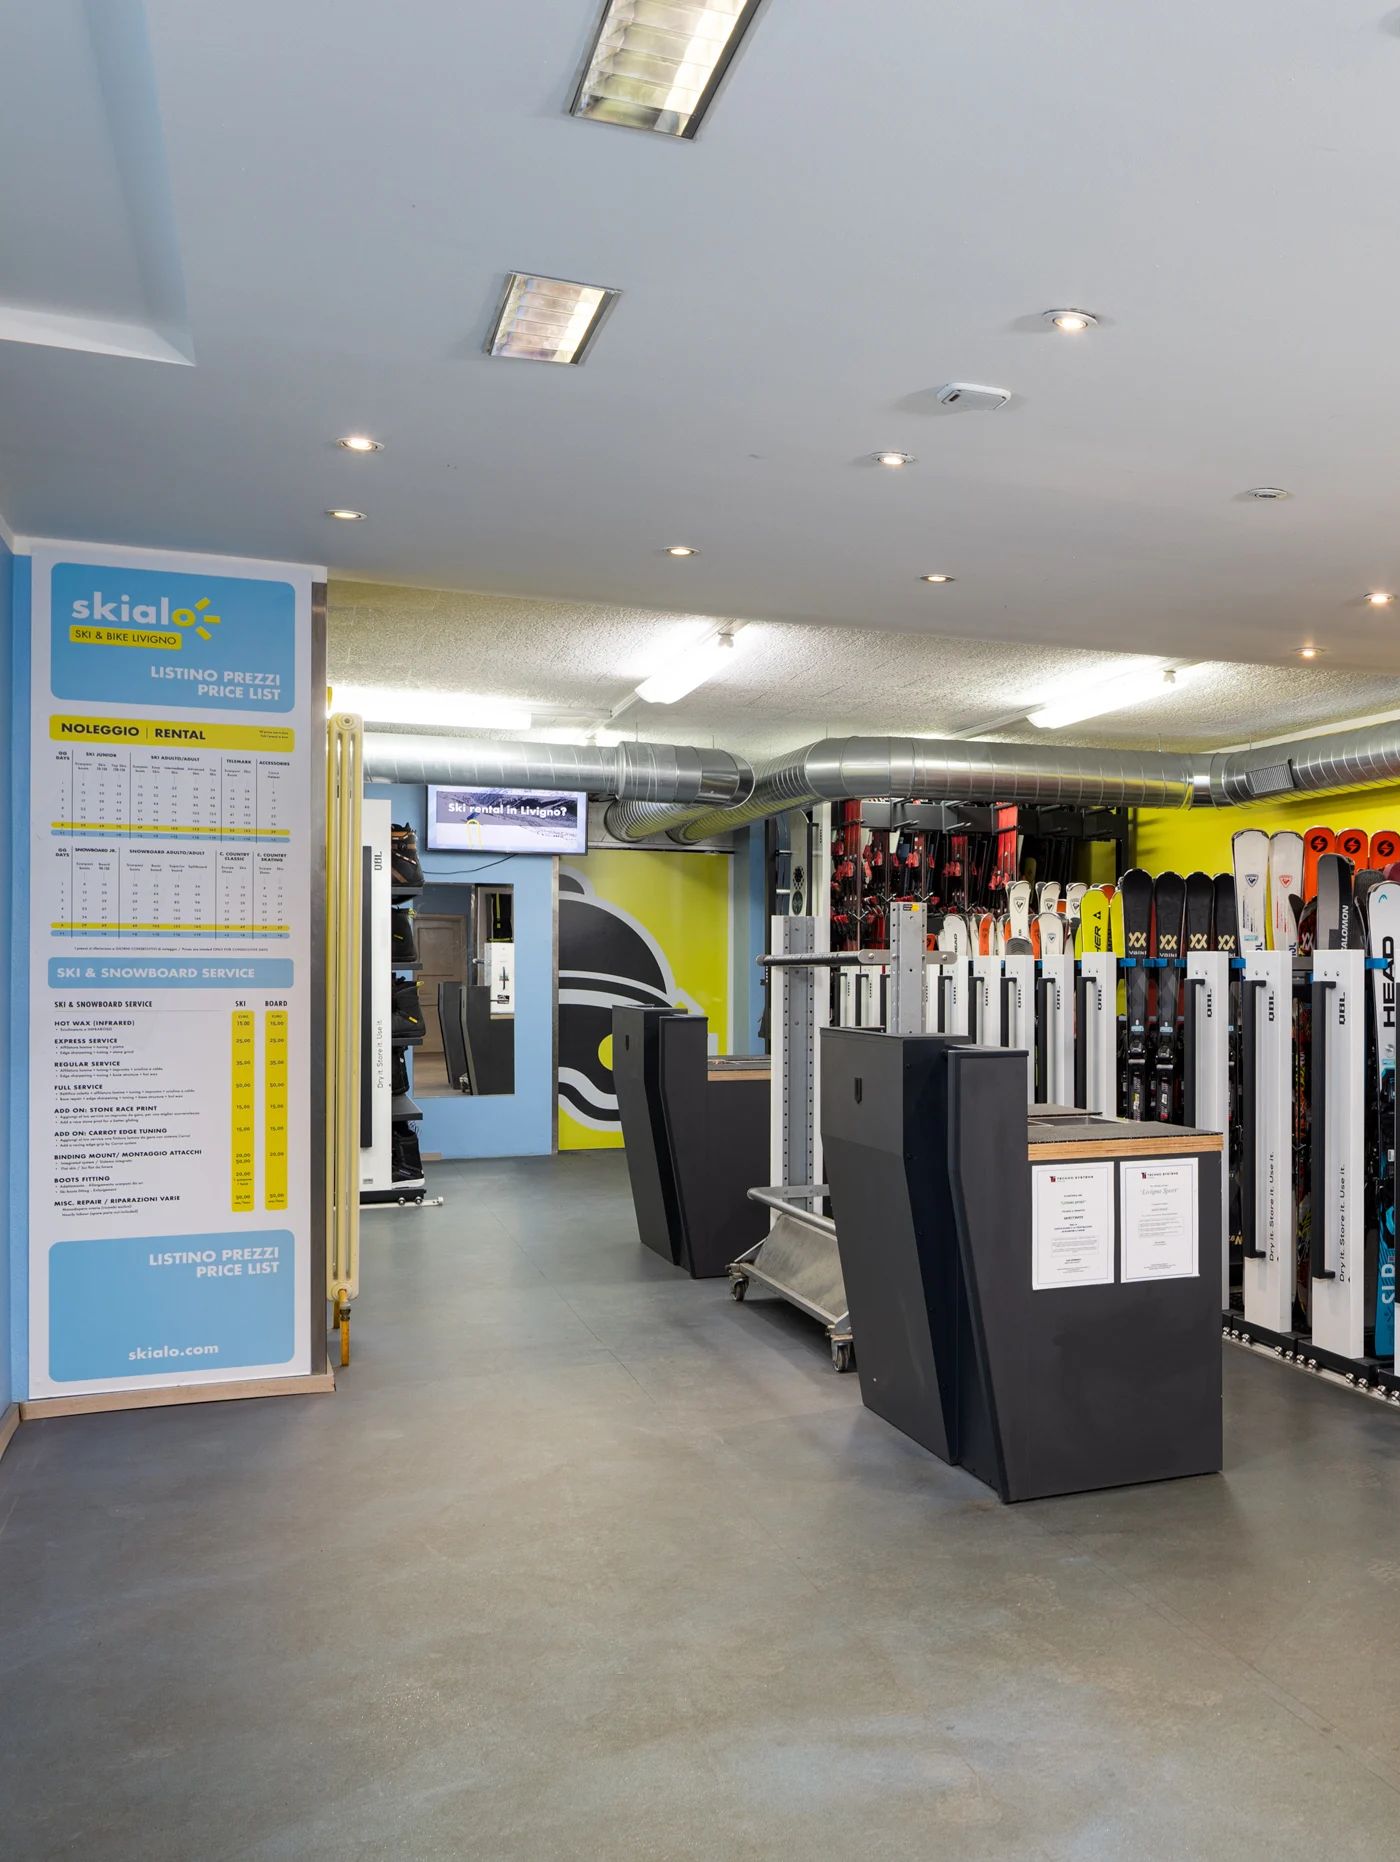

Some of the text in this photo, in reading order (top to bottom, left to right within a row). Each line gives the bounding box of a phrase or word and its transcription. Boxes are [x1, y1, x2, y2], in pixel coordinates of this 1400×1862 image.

[71, 591, 196, 627] skialo
[75, 629, 176, 646] SKI & BIKE LIVIGNO
[151, 666, 280, 686] LISTINO PREZZI
[198, 684, 281, 701] PRICE LIST
[61, 722, 206, 741] NOLEGGIO RENTAL
[448, 803, 567, 818] Ski rental in Livigno?
[1341, 904, 1349, 949] ALOMON
[57, 967, 255, 979] SKI & SNOWBOARD SERVICE
[1383, 936, 1395, 1027] HEAD
[76, 1000, 123, 1008] SNOWBOARD
[122, 1150, 167, 1158] MONTAGGIO
[149, 1247, 279, 1266] LISTINO PREZZI
[196, 1261, 279, 1278] PRICE LIST
[1339, 1261, 1347, 1282] Dry
[128, 1345, 219, 1361] skialo.com
